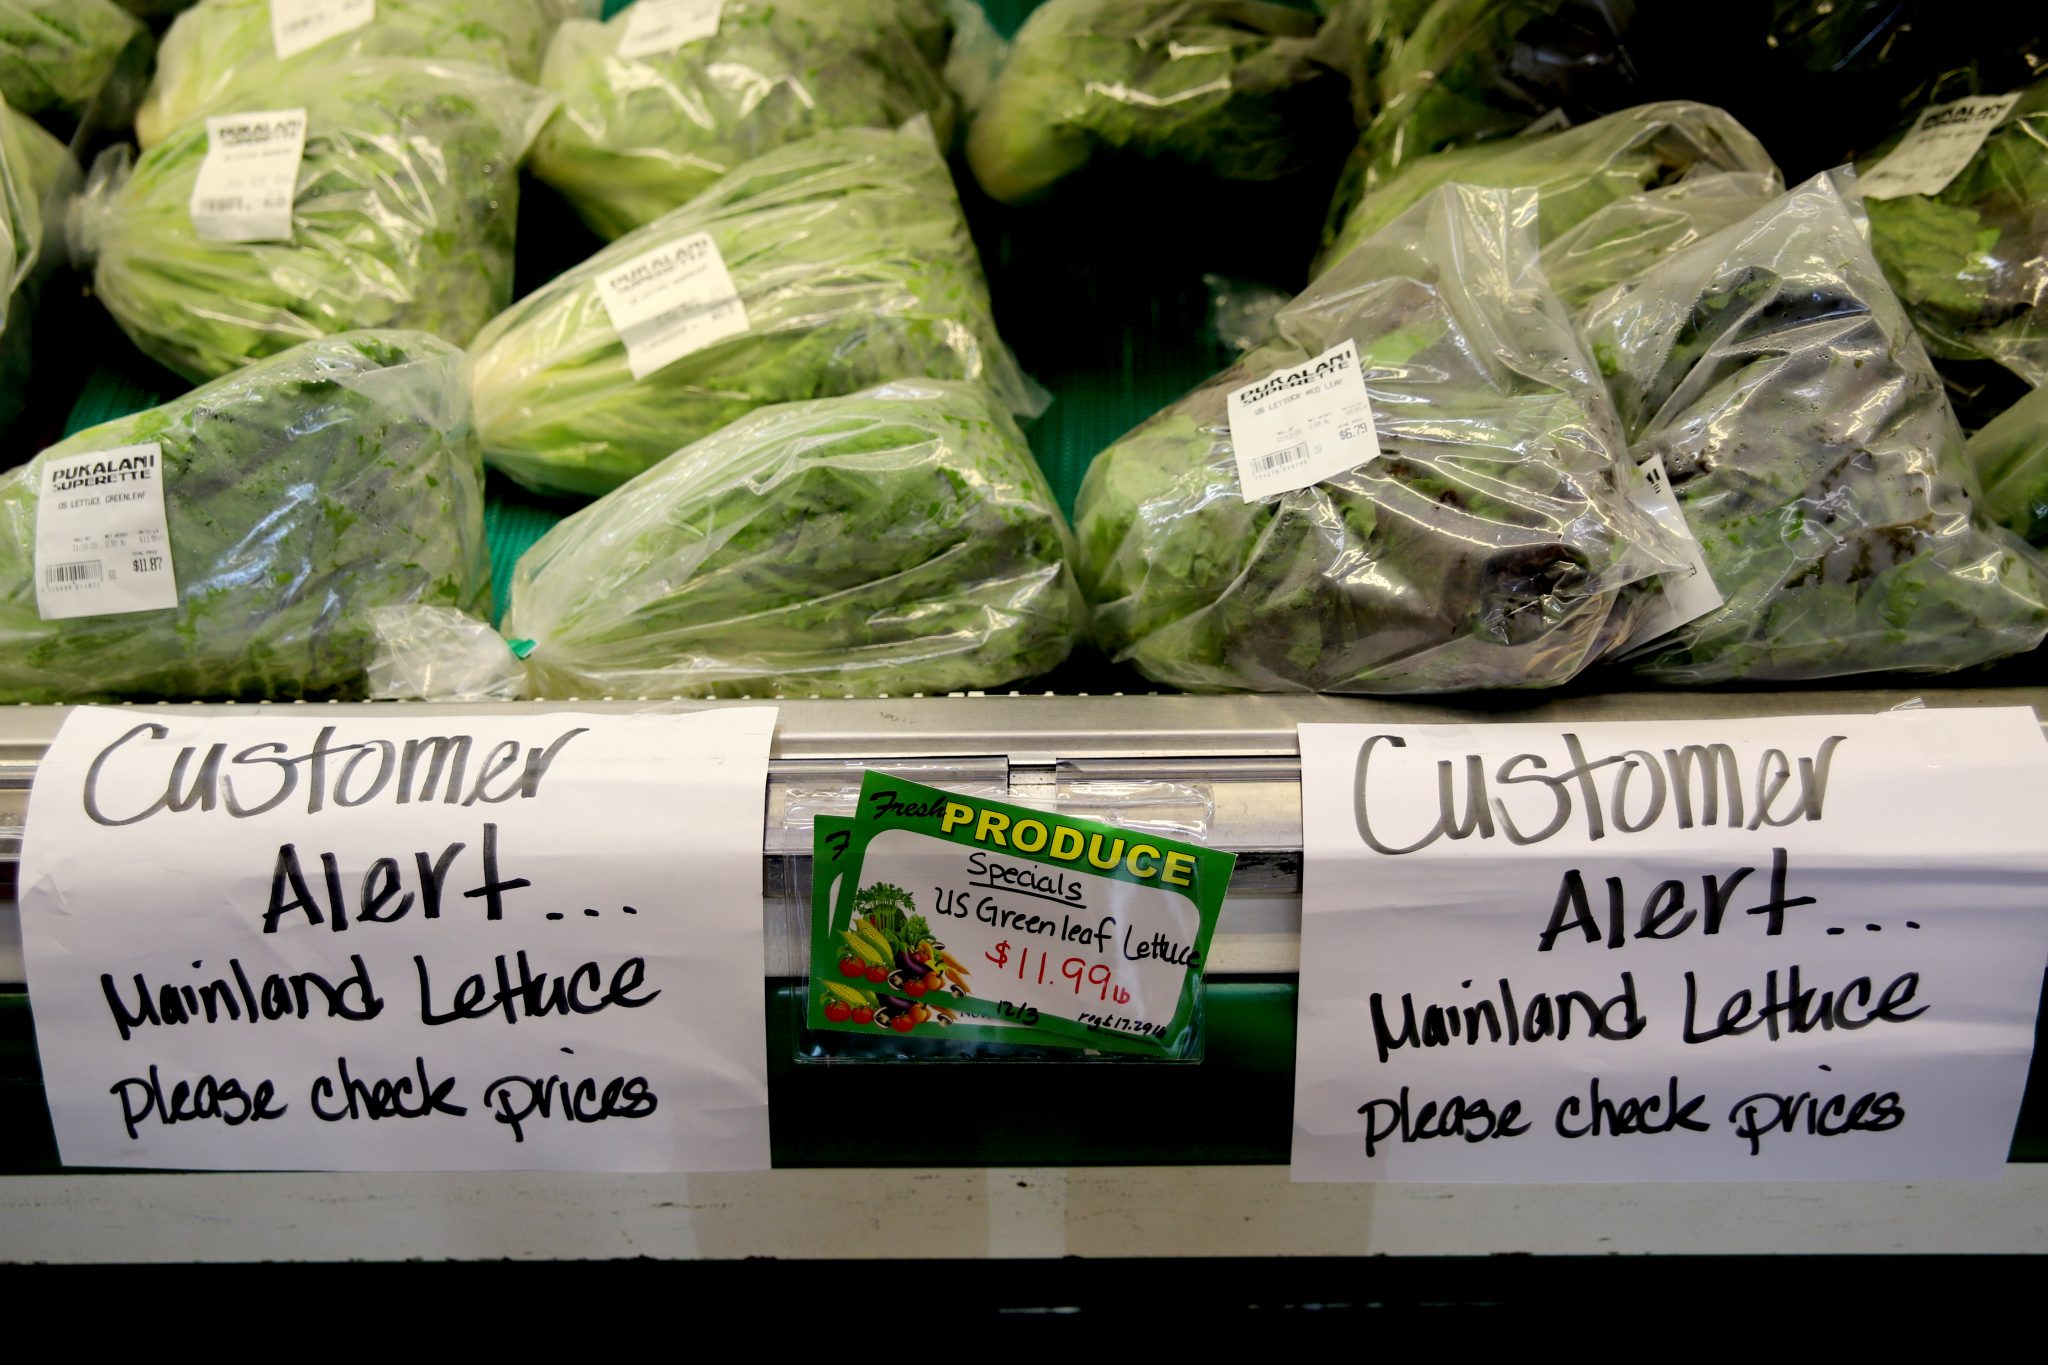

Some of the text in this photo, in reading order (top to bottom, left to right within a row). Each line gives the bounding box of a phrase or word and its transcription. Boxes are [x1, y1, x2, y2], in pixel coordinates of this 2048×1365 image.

[1239, 350, 1353, 402] PUKALANI
[1242, 361, 1351, 407] SUPERETTE
[1339, 423, 1368, 440] $6.79
[52, 454, 155, 482] PUKALANI
[53, 469, 152, 493] SUPERETTE
[58, 490, 146, 510] US LETTUCE GREENLEAF
[133, 556, 162, 573] $11.87
[84, 723, 590, 827] Customer
[1354, 733, 1848, 856] Customer
[869, 790, 1198, 888] Fresh PRODUCE
[967, 851, 1083, 901] Specials
[934, 886, 971, 919] US
[1123, 924, 1201, 968] Lettuce
[100, 949, 662, 1042] Mainland Lettuce
[997, 1001, 1040, 1025] 12/3
[1370, 965, 1931, 1064] Mainland Lettuce
[110, 1047, 659, 1143] please check prices
[1357, 1064, 1906, 1158] please check prices
